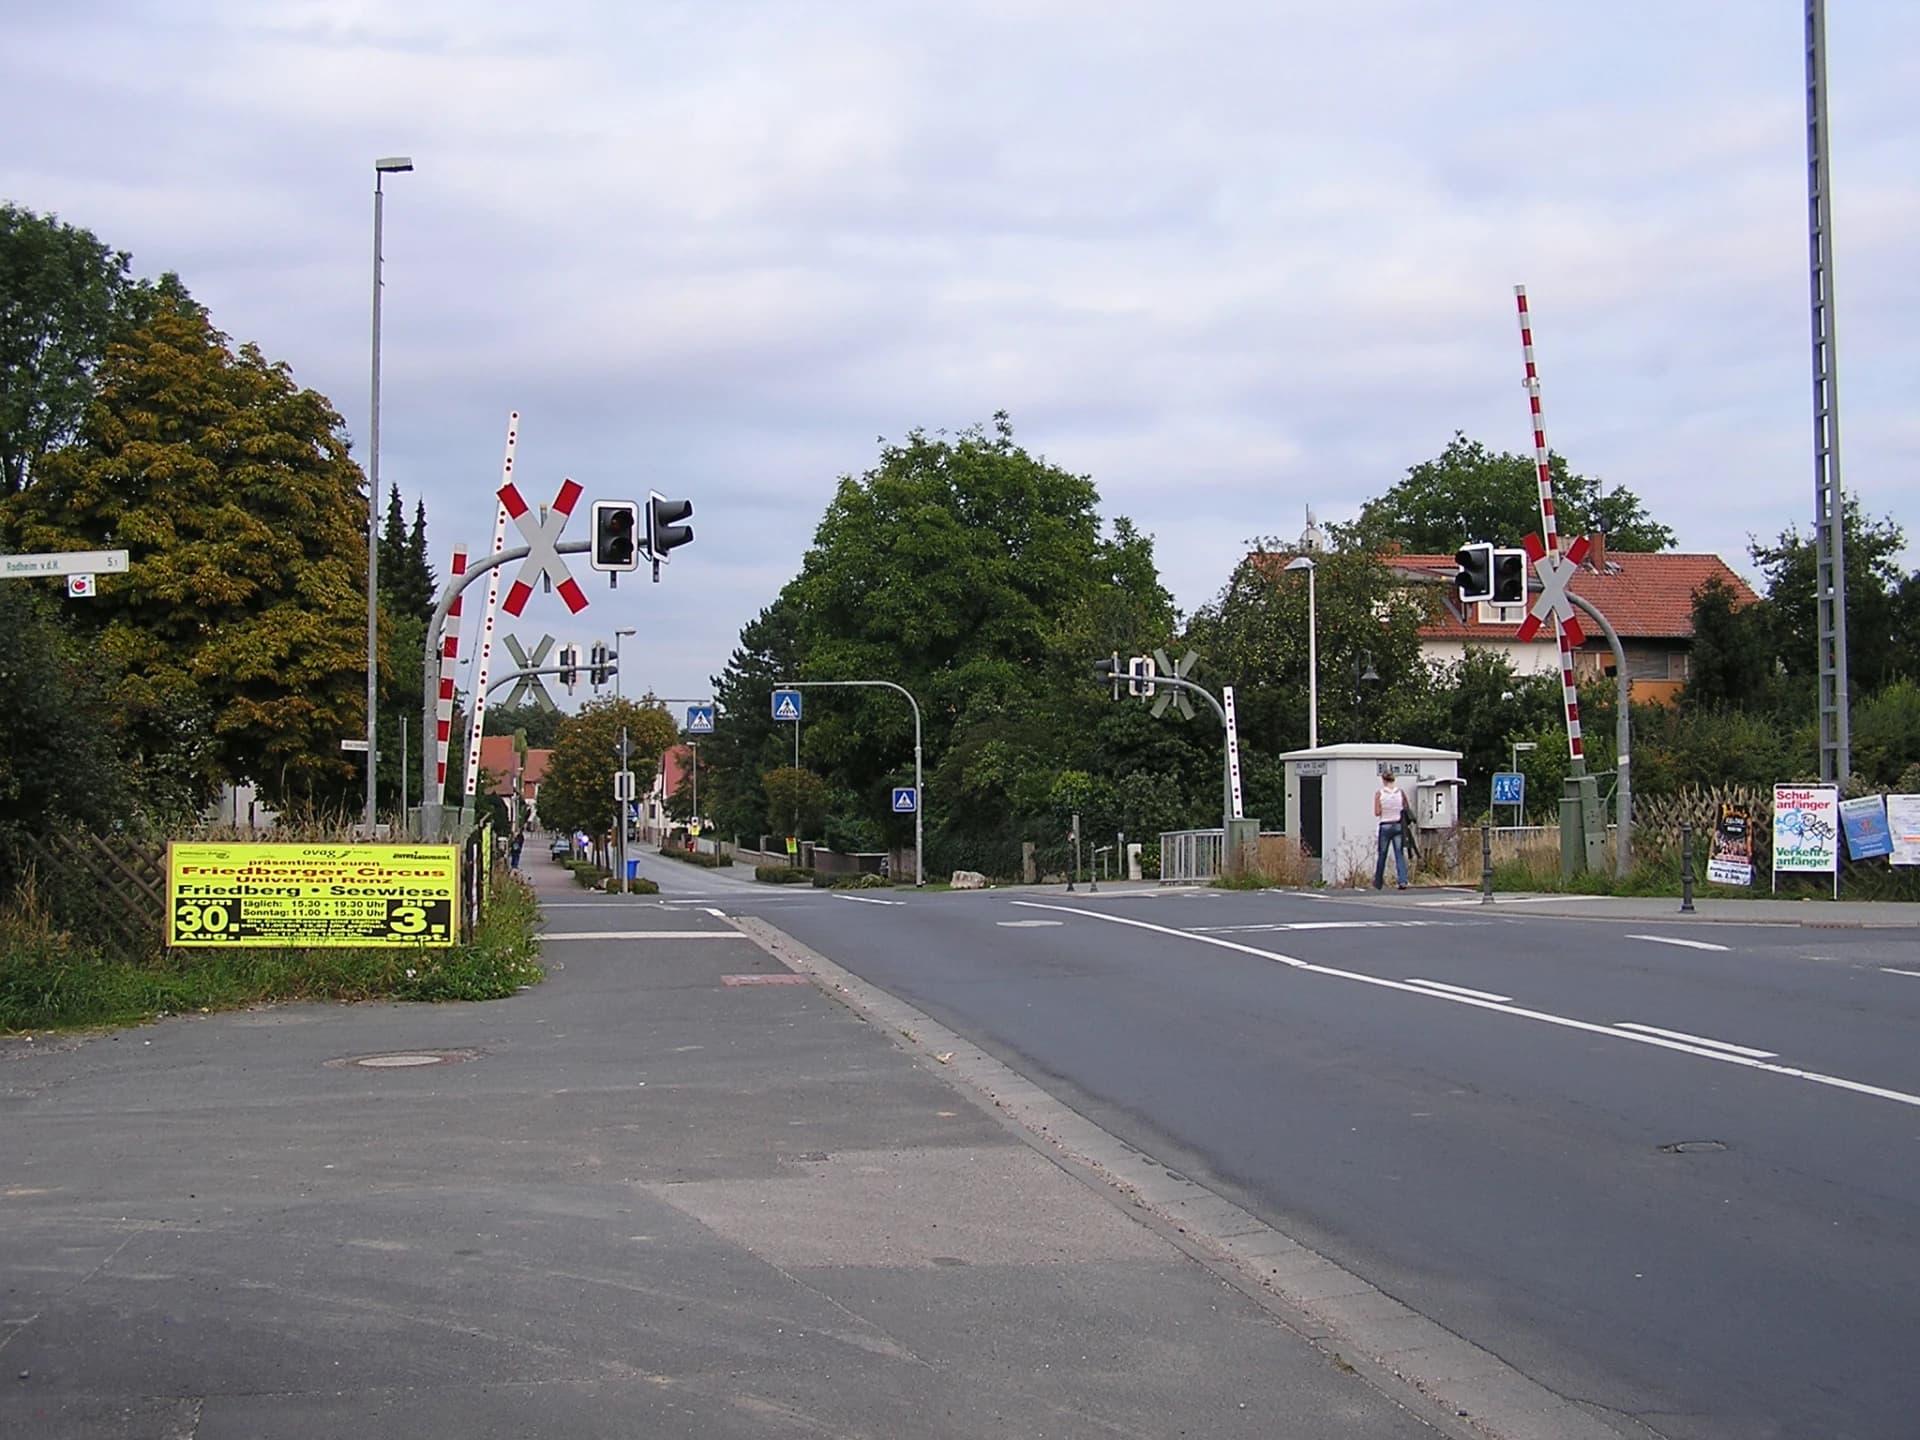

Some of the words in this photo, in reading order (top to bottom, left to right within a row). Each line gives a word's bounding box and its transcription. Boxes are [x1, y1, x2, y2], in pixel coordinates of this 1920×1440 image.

[1776, 791, 1815, 800] Schul-
[1436, 793, 1443, 812] F
[1776, 800, 1831, 811] anfänger
[303, 850, 336, 858] ovag
[1776, 847, 1834, 857] Verkehrs-
[1776, 857, 1830, 867] anfänger
[182, 866, 347, 877] Friedberger
[357, 868, 445, 877] Circus
[178, 885, 301, 897] Friedberg
[330, 885, 450, 896] Seewiese
[243, 900, 283, 908] täglich:
[402, 899, 436, 907] bis
[243, 909, 289, 917] Sonntag:
[176, 905, 240, 932] 30.
[389, 907, 446, 933] 3.
[179, 932, 236, 941] Aug.
[386, 933, 449, 942] Sept.
